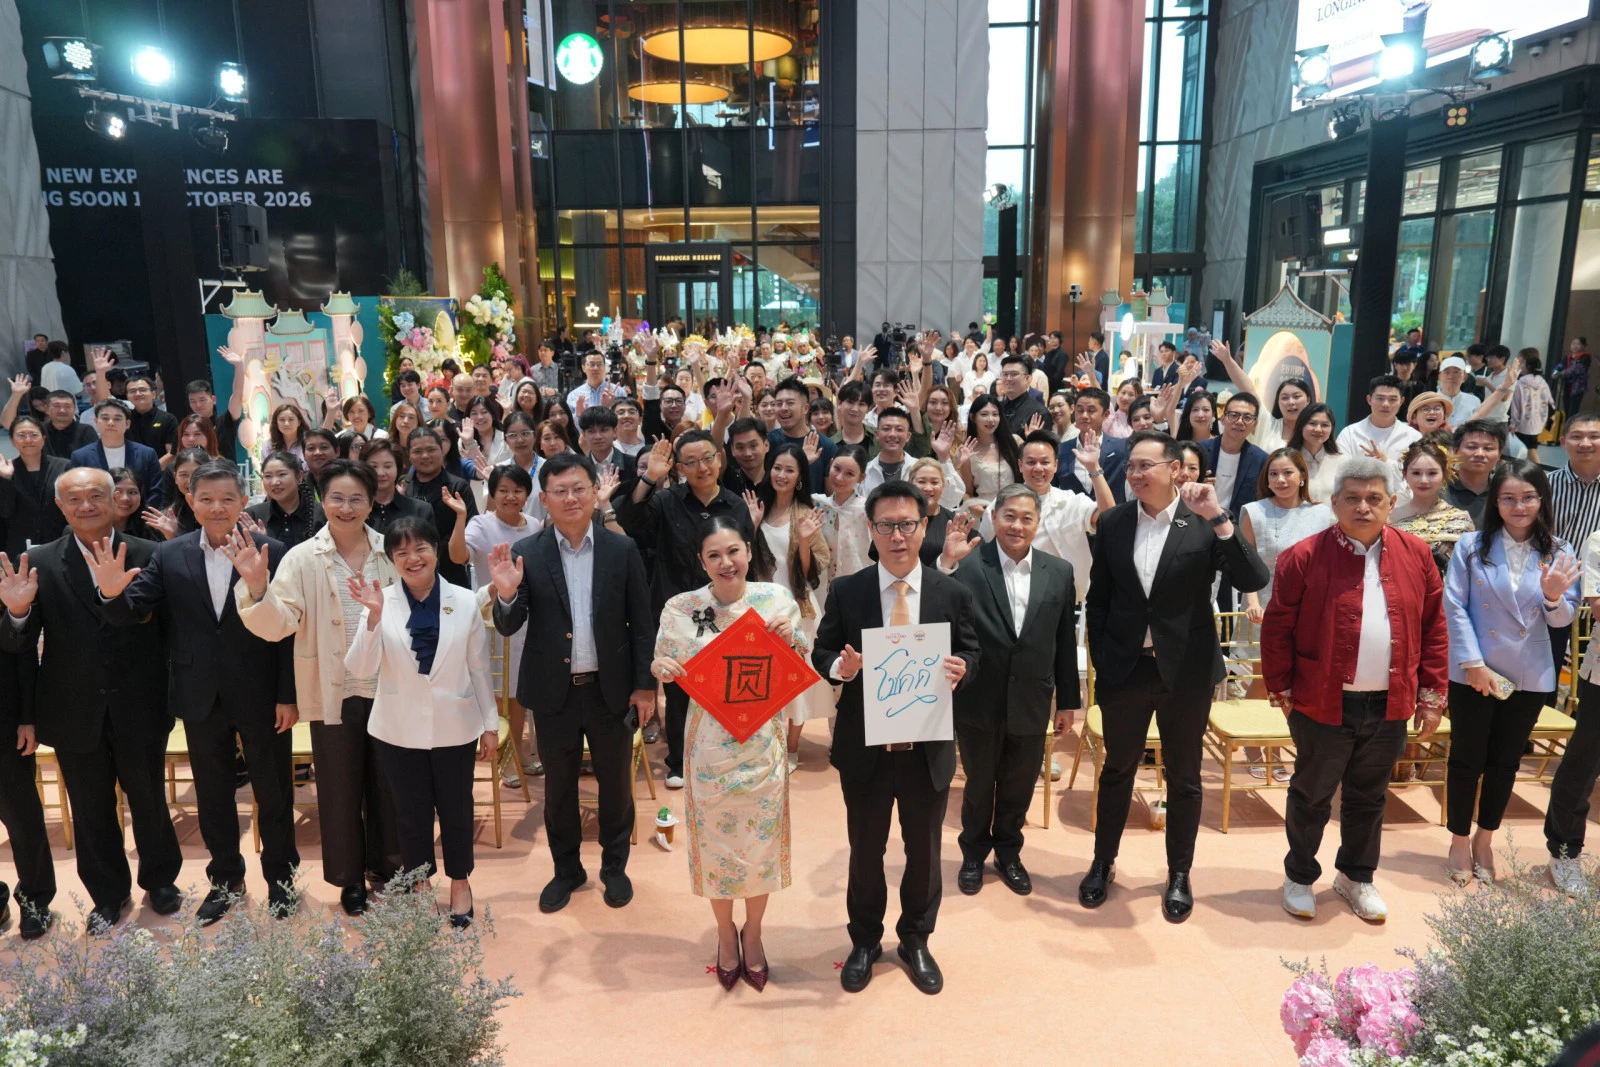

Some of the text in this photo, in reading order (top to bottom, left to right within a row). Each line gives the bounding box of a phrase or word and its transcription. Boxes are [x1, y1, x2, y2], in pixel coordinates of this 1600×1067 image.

[46, 168, 93, 184] NEW
[245, 169, 284, 185] ARE
[69, 191, 128, 207] SOON
[263, 191, 312, 207] 2026
[722, 654, 773, 704] 圆
